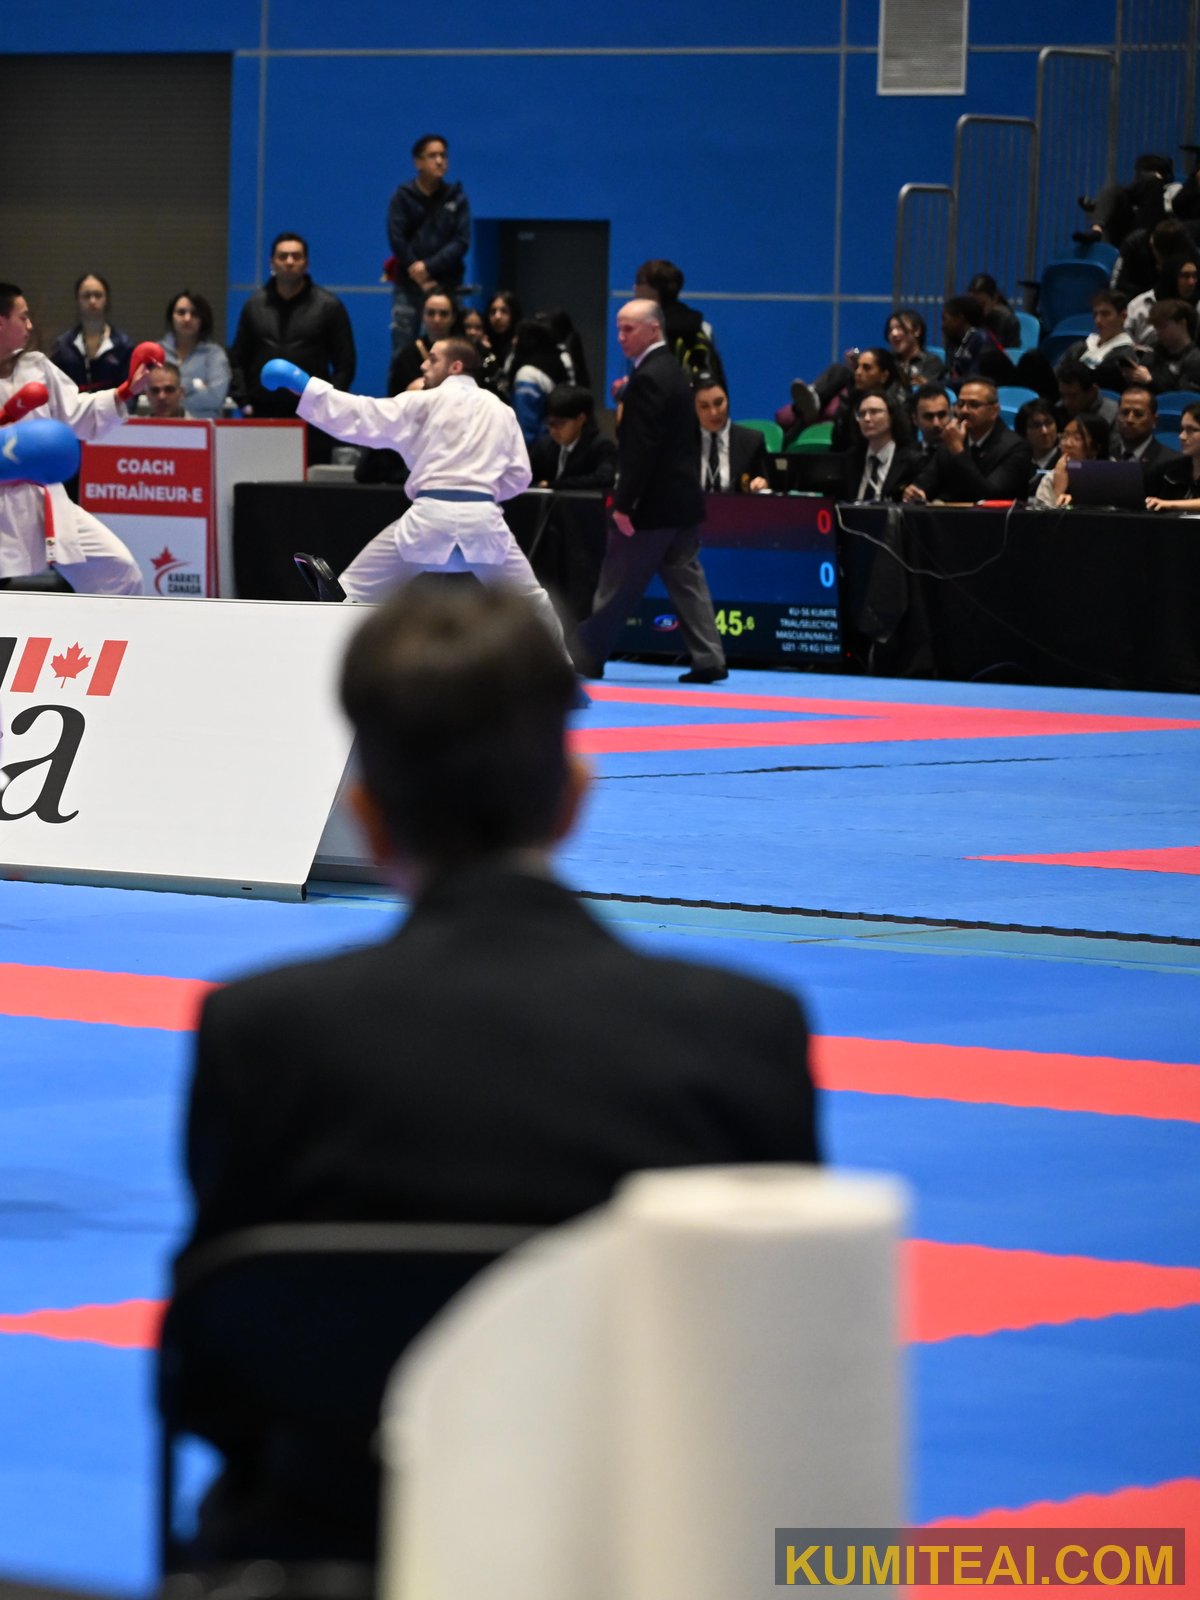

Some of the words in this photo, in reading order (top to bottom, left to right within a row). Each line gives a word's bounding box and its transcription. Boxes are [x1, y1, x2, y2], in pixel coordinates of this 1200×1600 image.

[117, 458, 175, 475] COACH
[817, 509, 832, 534] 0
[167, 573, 201, 583] KARATE
[820, 562, 834, 587] 0
[167, 583, 201, 593] CANADA
